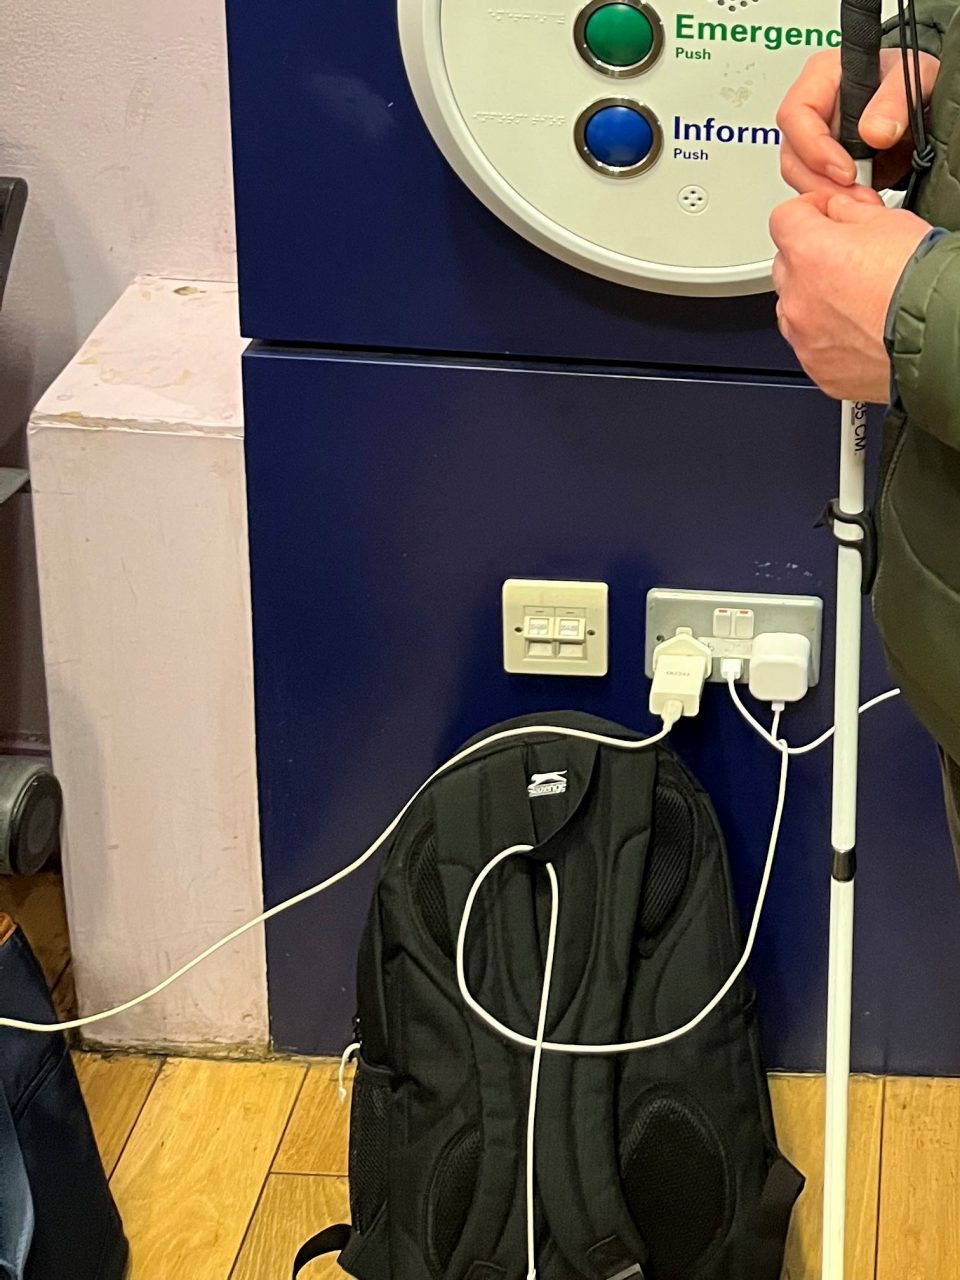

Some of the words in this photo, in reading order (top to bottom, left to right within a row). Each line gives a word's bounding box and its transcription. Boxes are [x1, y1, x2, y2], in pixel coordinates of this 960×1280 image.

[675, 47, 712, 60] Push
[673, 116, 780, 145] Inform
[673, 147, 709, 161] Push
